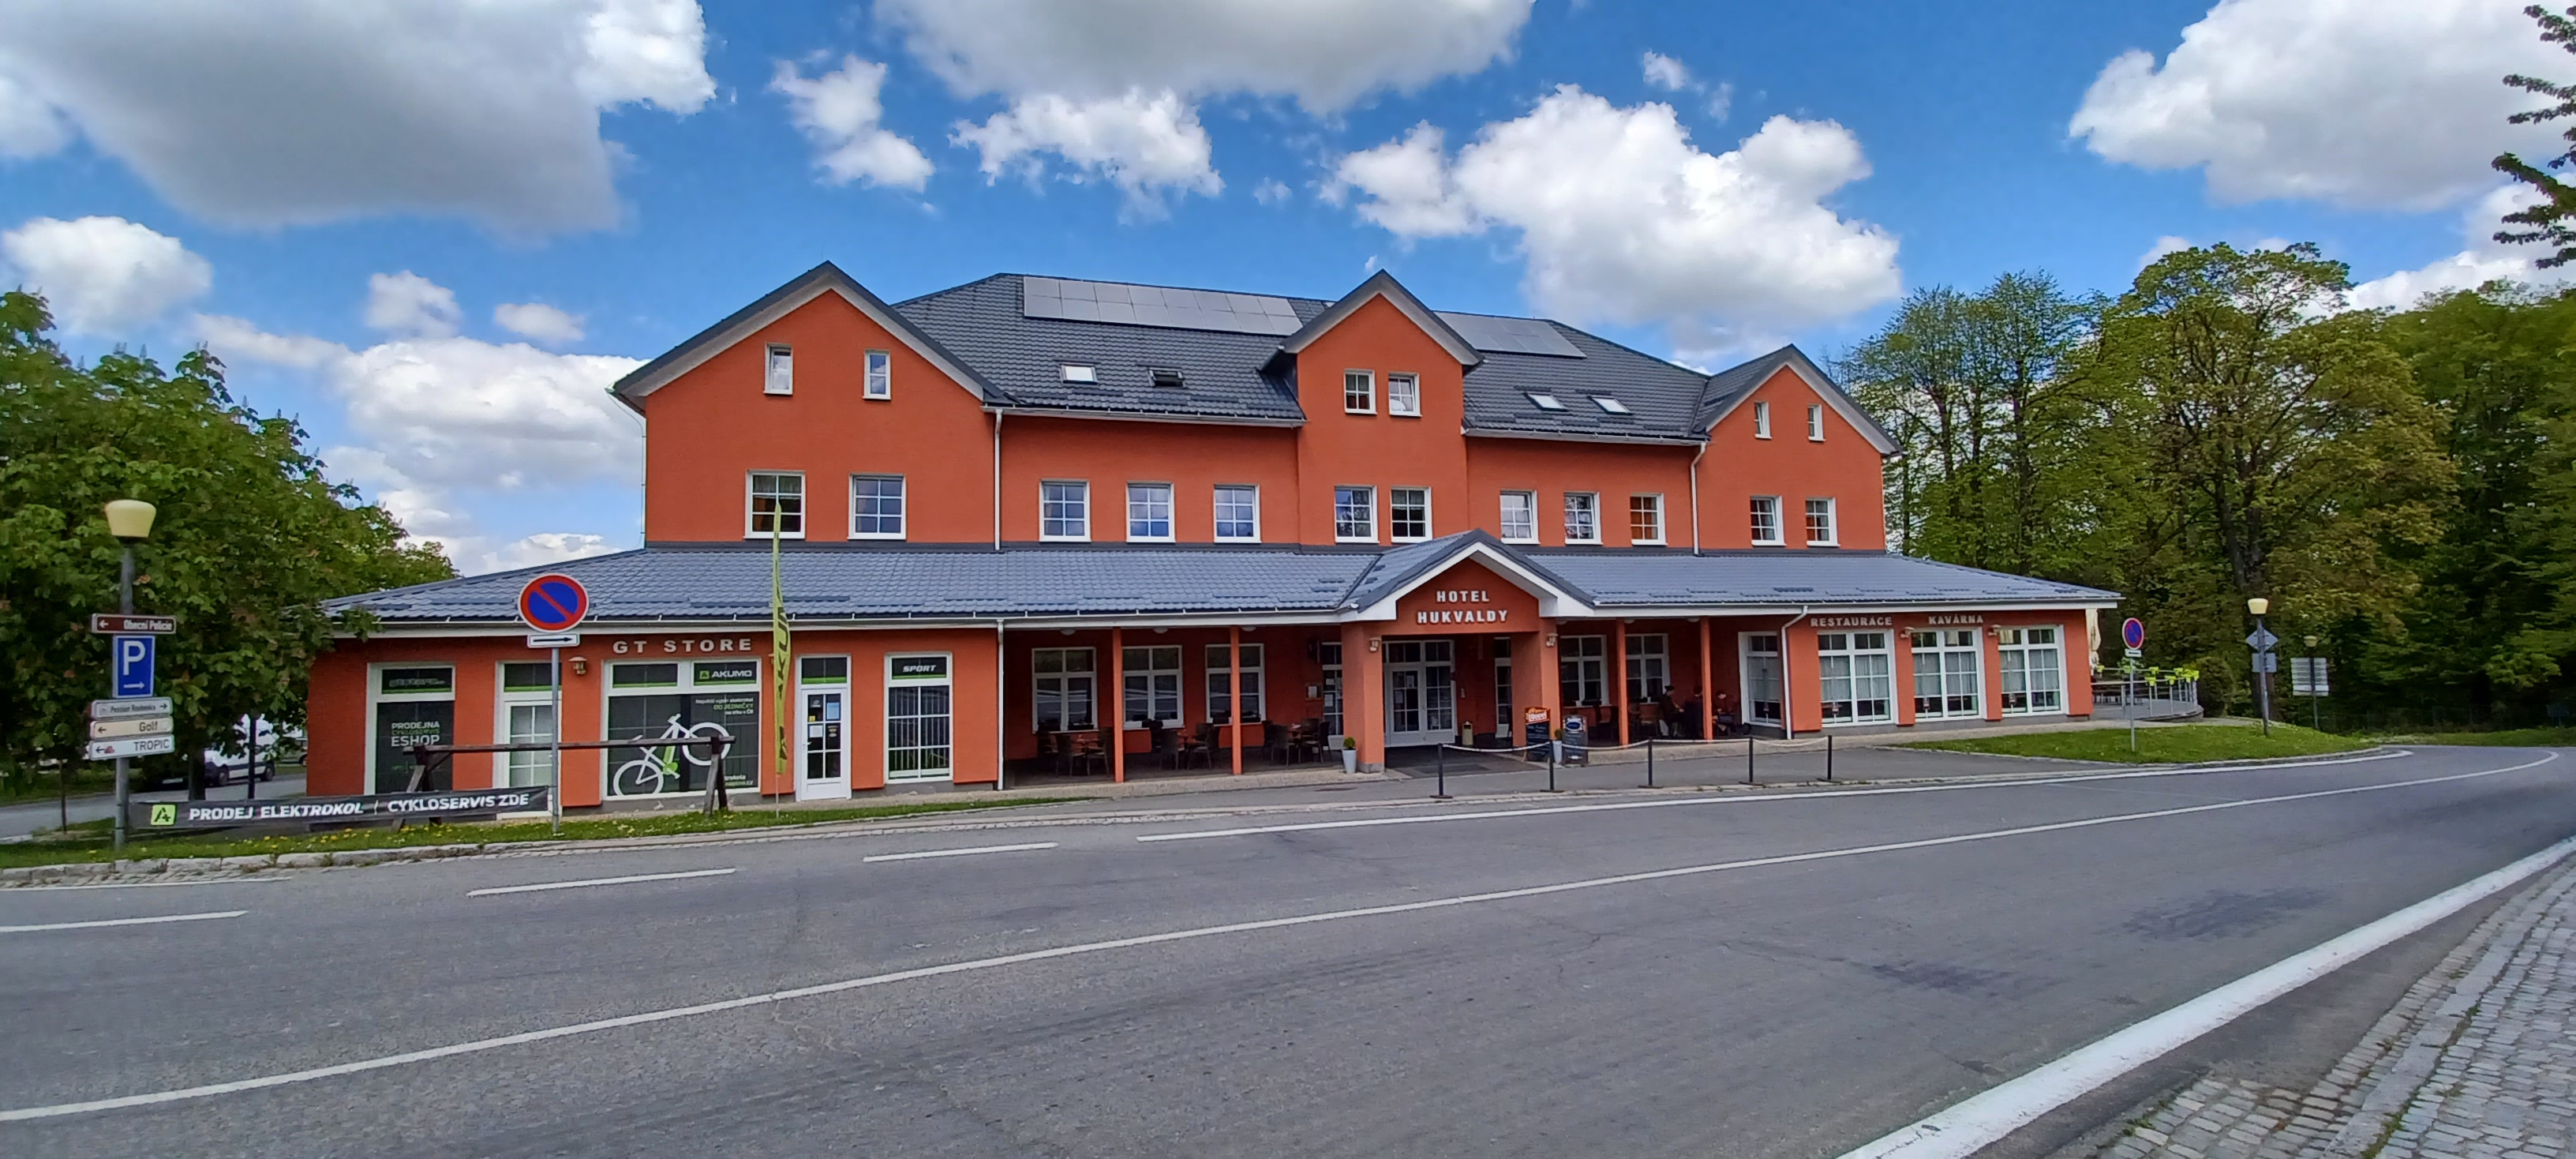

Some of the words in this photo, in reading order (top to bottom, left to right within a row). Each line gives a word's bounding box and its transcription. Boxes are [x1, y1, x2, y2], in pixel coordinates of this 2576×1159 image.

[1436, 590, 1490, 602] HOTEL
[1417, 610, 1507, 624] HUKVALDY
[1810, 617, 1892, 627] RESTAURACE
[1928, 614, 1983, 625] KAVÁRNA
[613, 641, 647, 654] GT
[664, 638, 751, 653] STORE
[123, 640, 145, 676] P
[139, 721, 158, 732] Golf
[391, 721, 440, 730] PRODEJNA
[133, 739, 170, 752] TROPIC
[391, 734, 440, 747] ESHOP
[189, 808, 253, 821] PRODEJ
[260, 802, 364, 820] ELEKTROKOL
[388, 795, 496, 813] CYKLOSERVIS
[498, 793, 530, 806] ZDE
